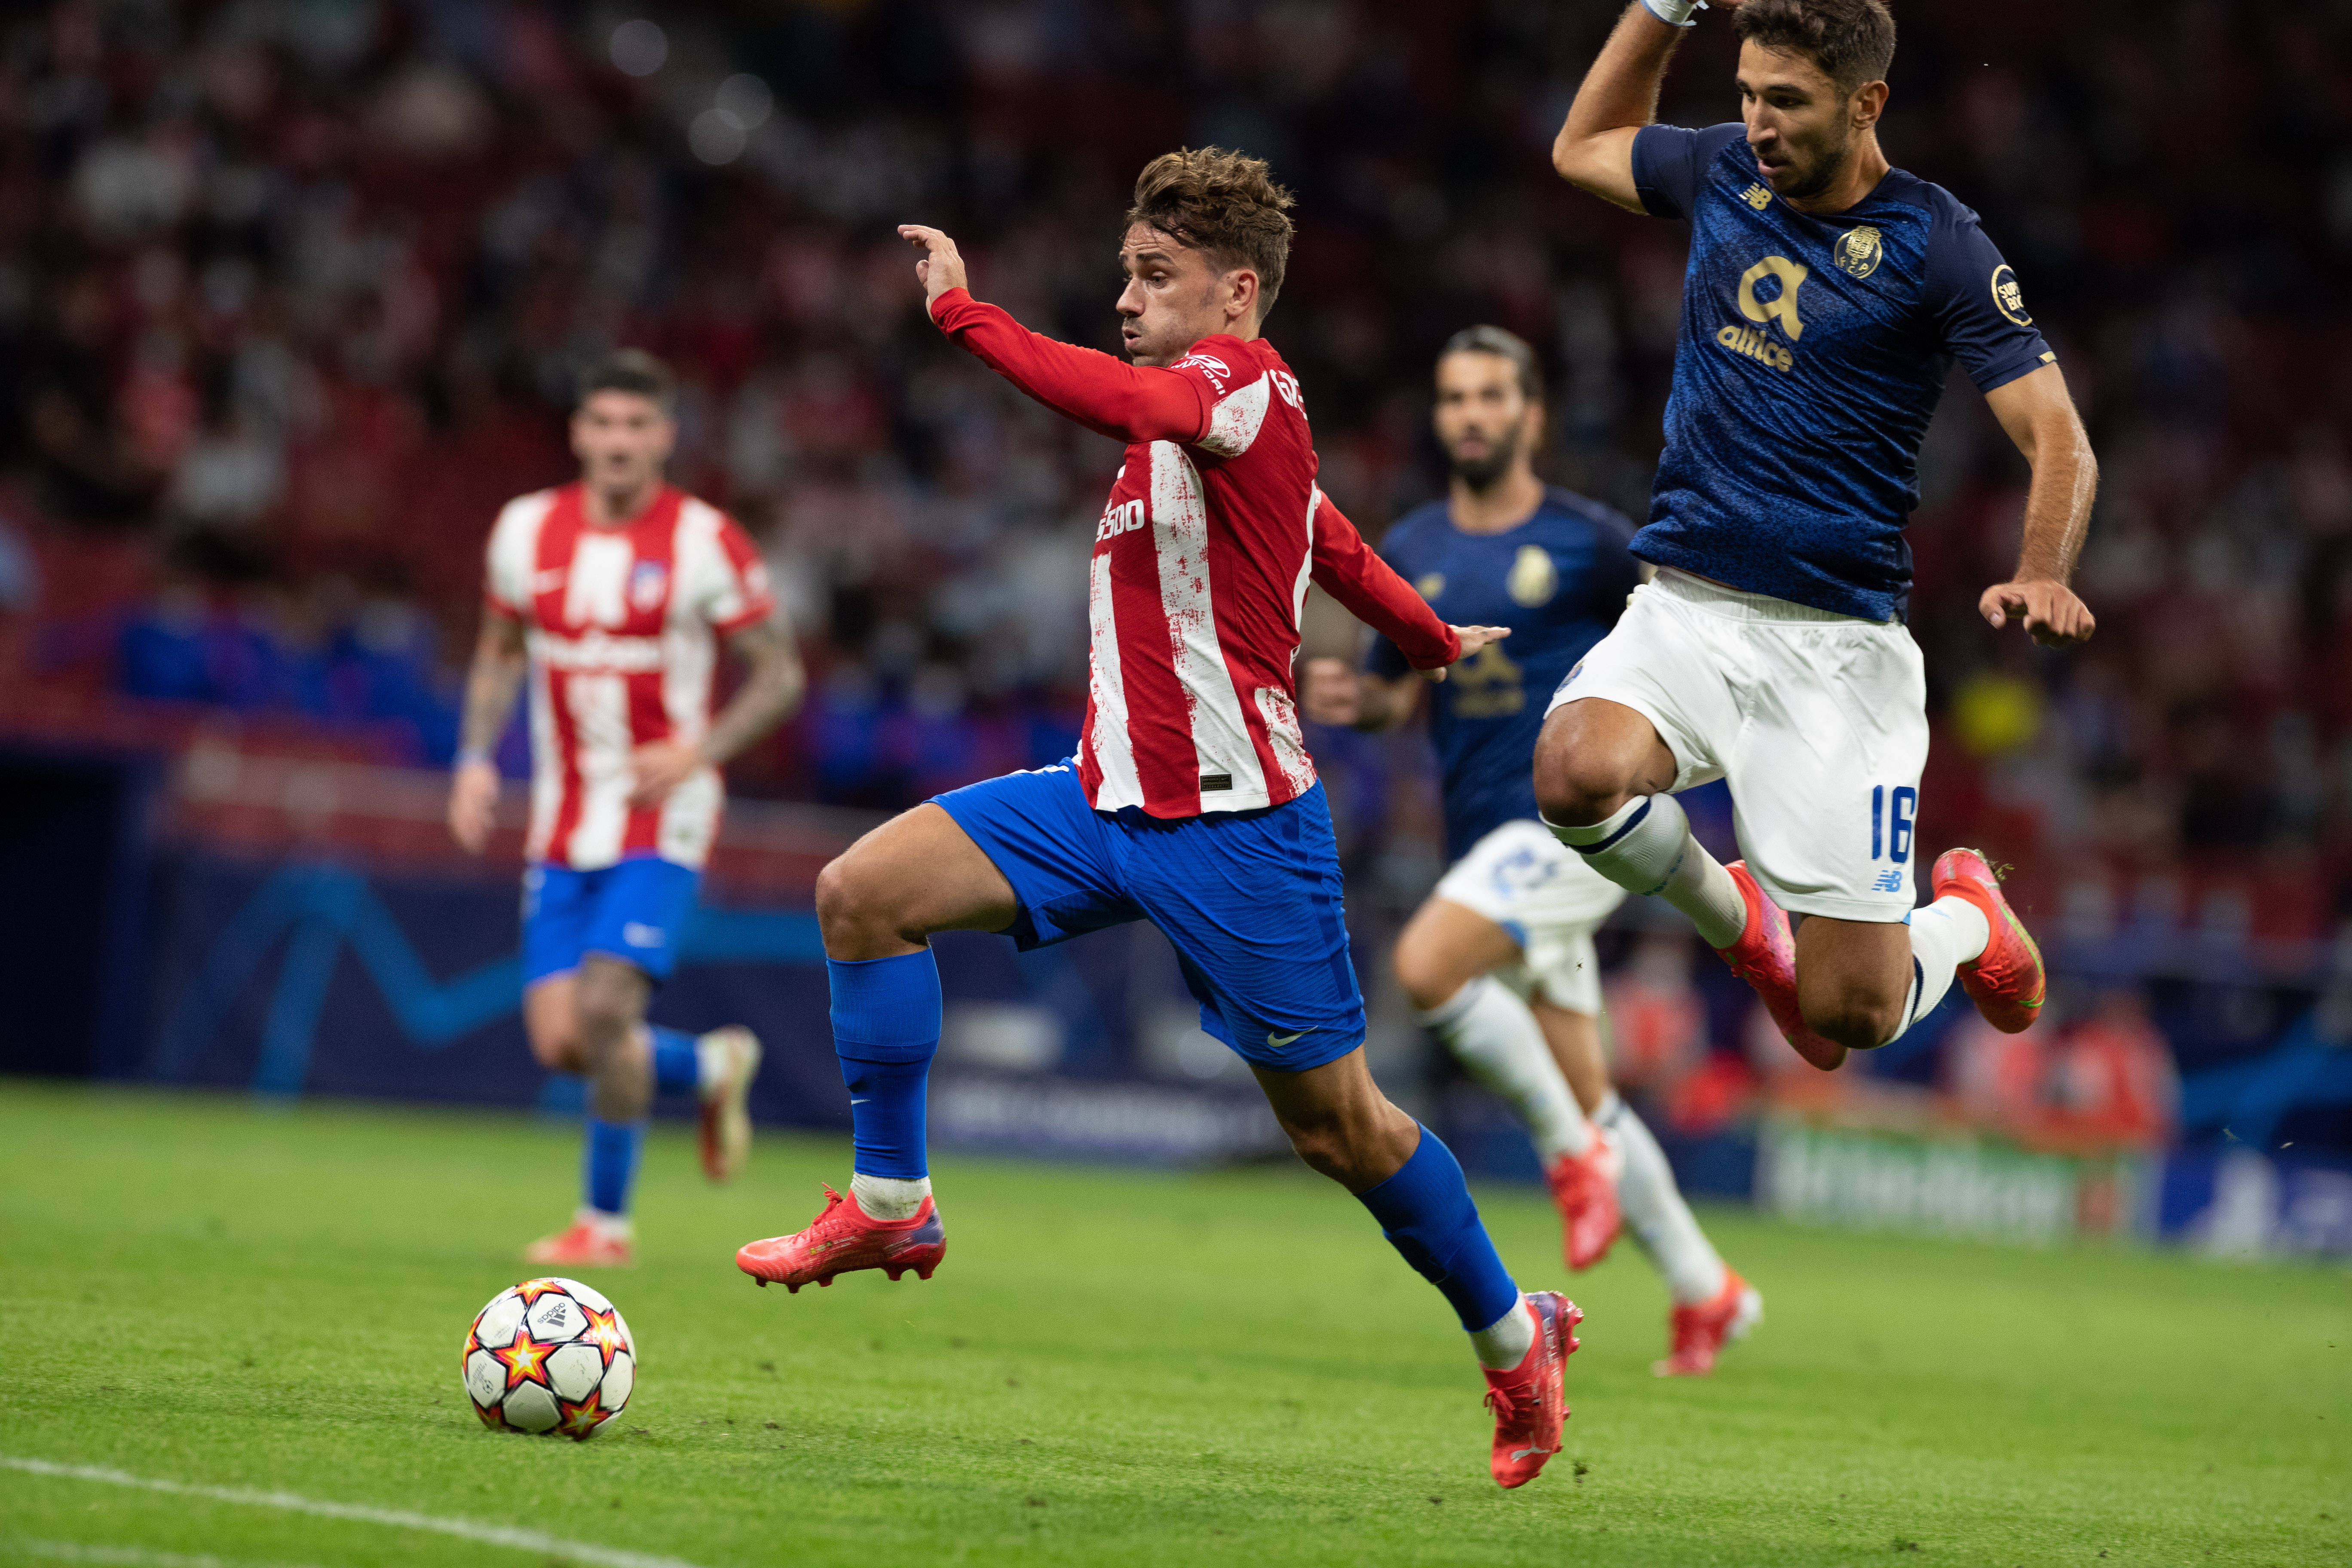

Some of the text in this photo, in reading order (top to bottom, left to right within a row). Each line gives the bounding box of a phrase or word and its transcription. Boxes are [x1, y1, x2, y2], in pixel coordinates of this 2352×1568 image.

[1717, 325, 1793, 373] altice
[1871, 784, 1916, 864] 16
[537, 1302, 565, 1324] adidas
